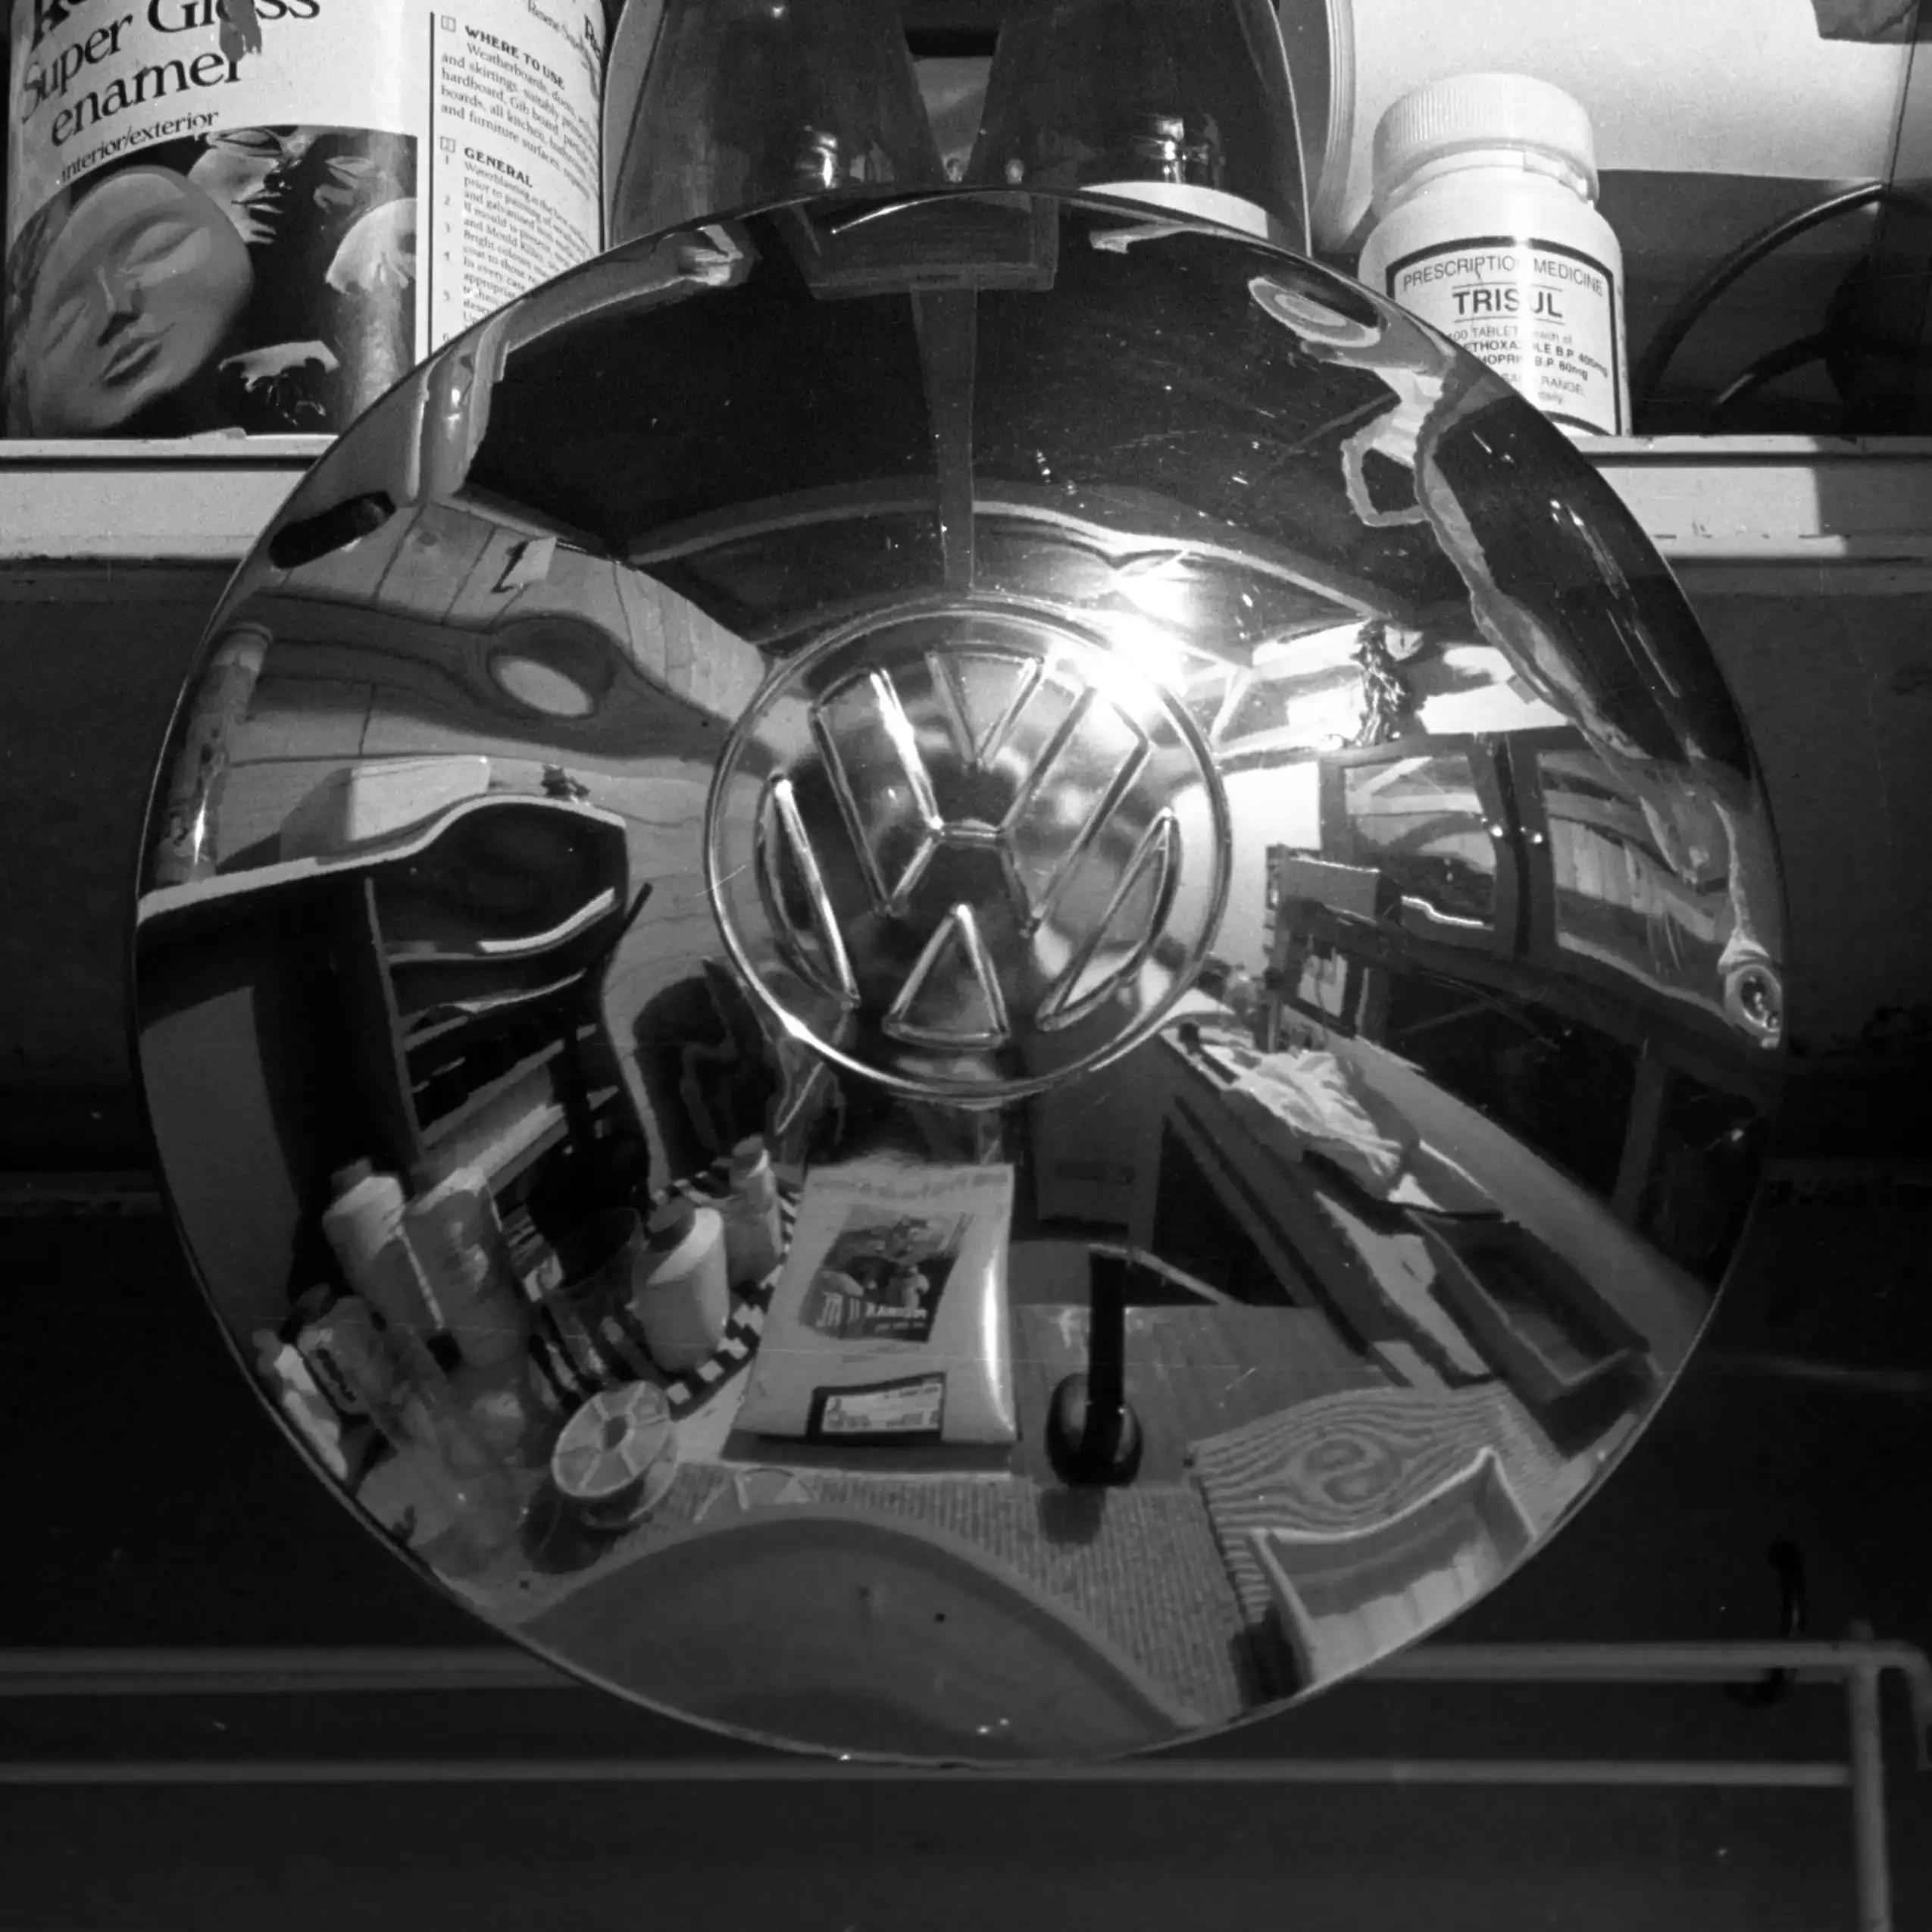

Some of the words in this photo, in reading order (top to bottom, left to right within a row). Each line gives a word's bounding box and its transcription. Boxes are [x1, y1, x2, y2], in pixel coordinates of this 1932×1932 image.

[20, 14, 134, 126] Super
[442, 53, 464, 68] and
[465, 25, 518, 58] WHERE
[523, 52, 539, 70] TO
[542, 65, 564, 89] USE
[441, 105, 464, 119] and
[469, 110, 518, 142] furniture
[489, 104, 503, 118] all
[61, 111, 220, 184] interior/exterior
[464, 147, 532, 187] GENERAL
[463, 218, 483, 231] and
[464, 230, 494, 250] Bright
[1402, 255, 1520, 291] PRESCRIPTIO
[1533, 258, 1604, 297] MEDICINE
